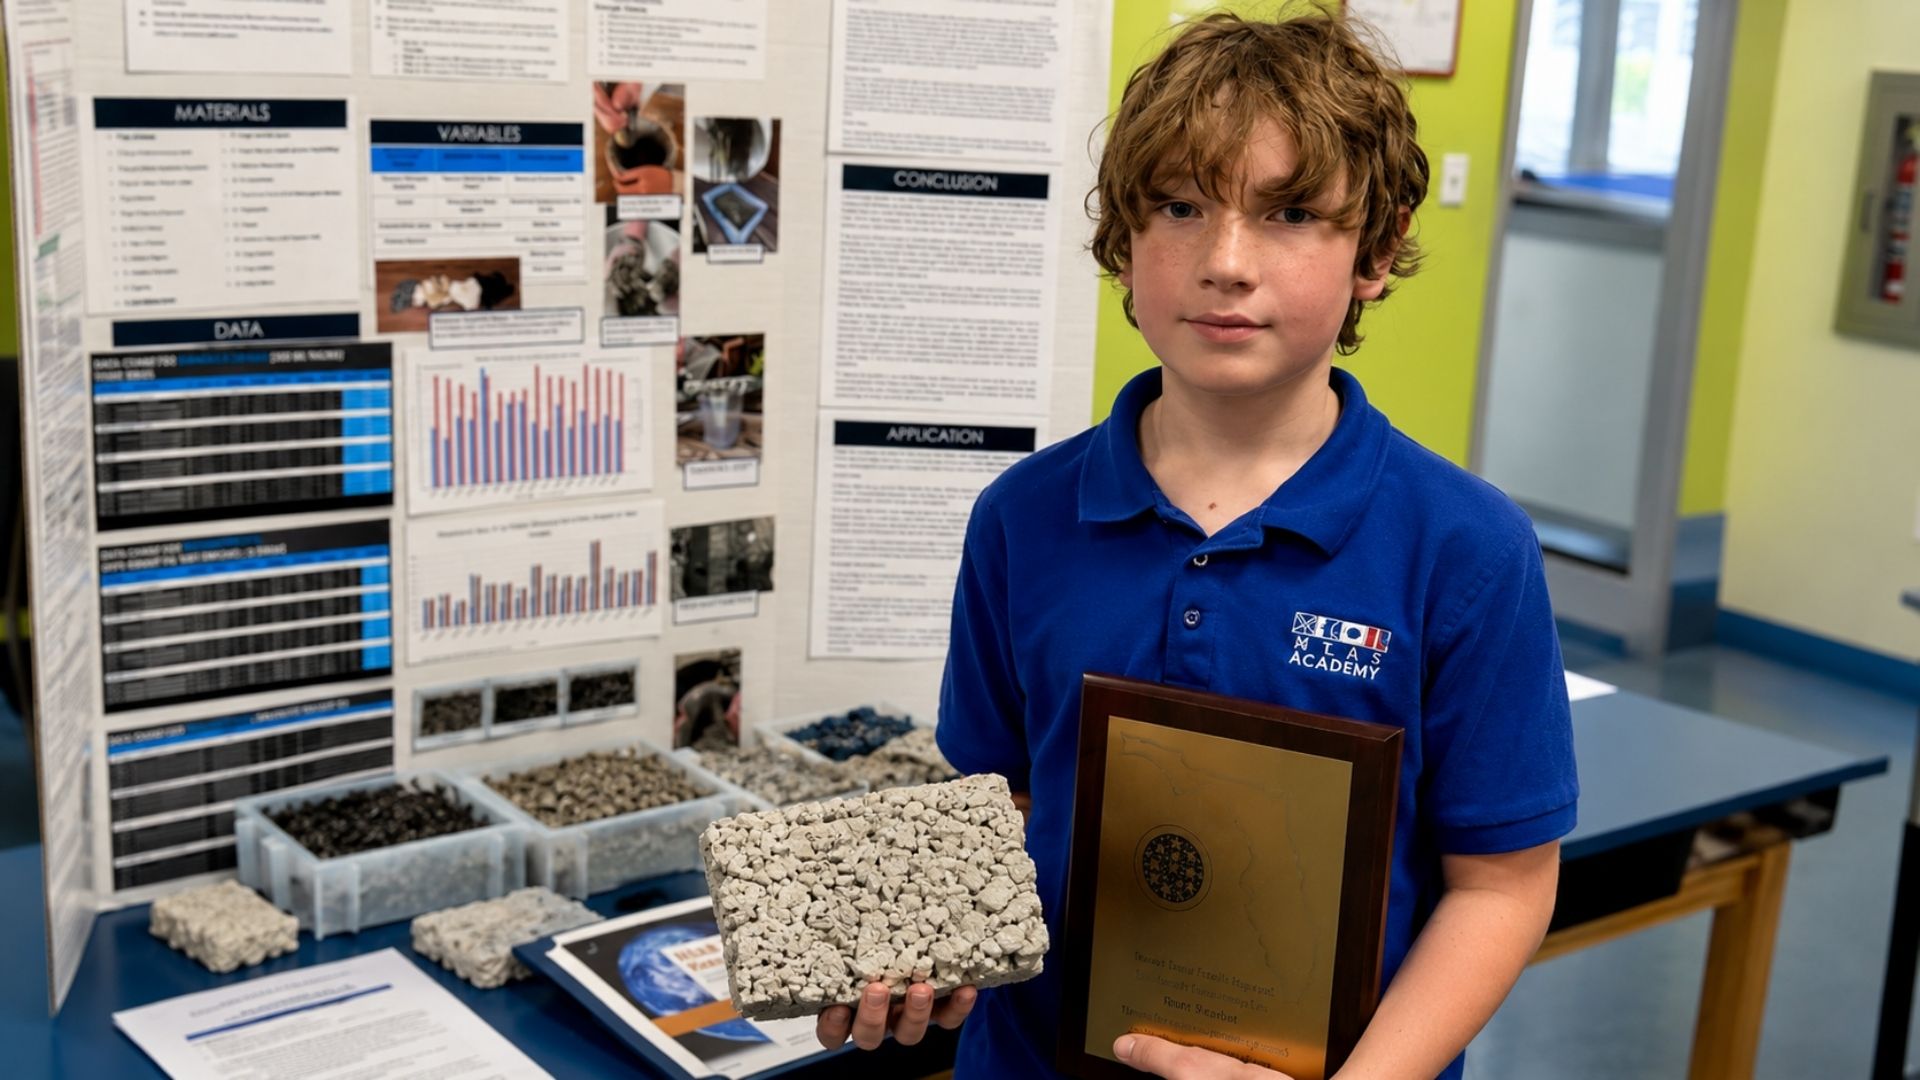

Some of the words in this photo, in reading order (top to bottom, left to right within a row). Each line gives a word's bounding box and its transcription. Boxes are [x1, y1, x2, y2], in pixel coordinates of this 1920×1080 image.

[174, 102, 271, 122] MATERIALS
[437, 124, 522, 143] VARIABLES
[893, 170, 999, 192] CONCLUSION
[213, 320, 265, 340] DATA
[885, 426, 984, 445] APPLICATION
[1288, 650, 1380, 680] ACADEMY
